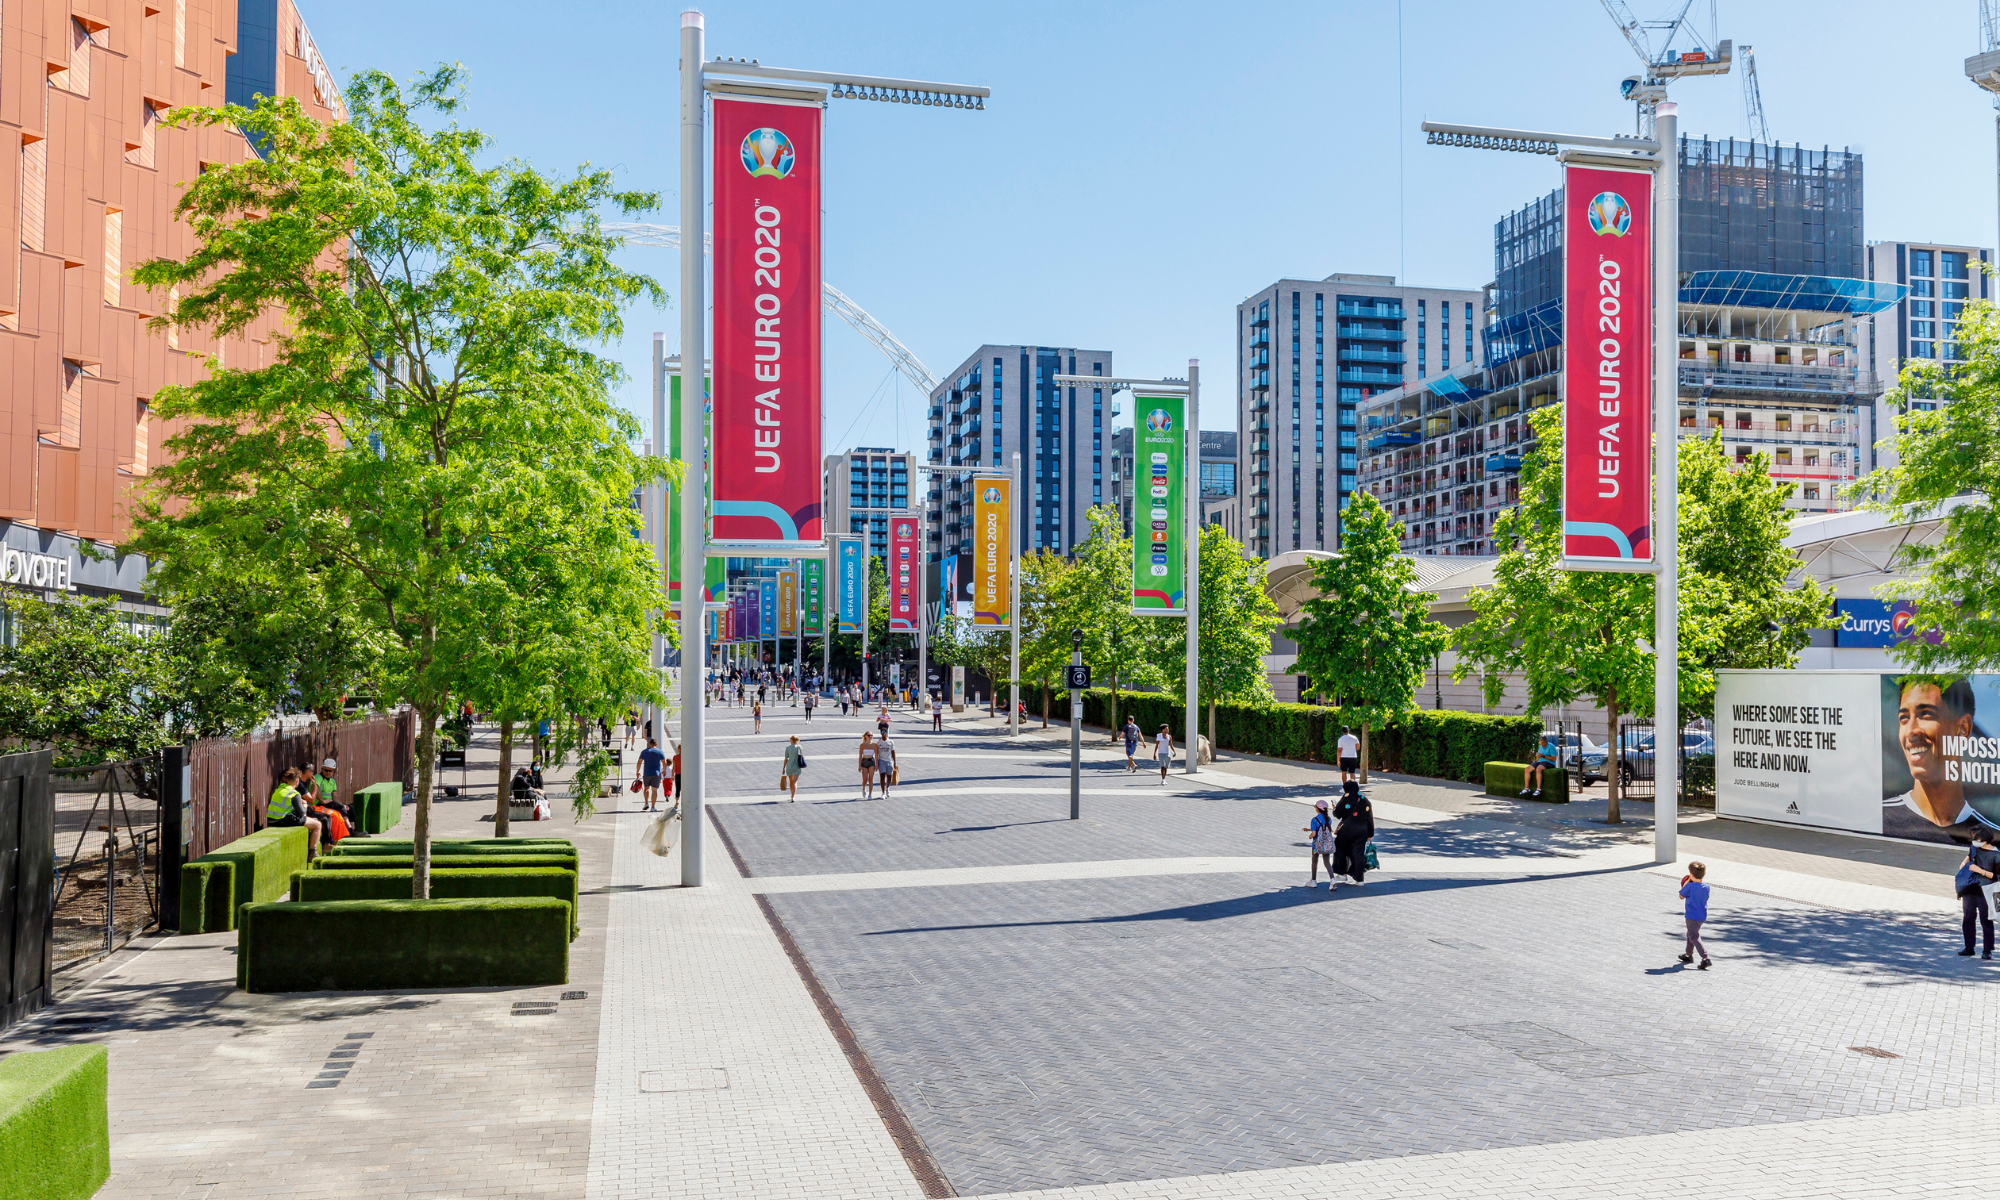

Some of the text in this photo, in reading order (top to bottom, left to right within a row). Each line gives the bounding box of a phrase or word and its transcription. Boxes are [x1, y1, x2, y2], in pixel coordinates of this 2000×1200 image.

[755, 293, 781, 382] EURO
[1599, 338, 1621, 417] EURO
[755, 387, 781, 473] UEFA
[1598, 421, 1620, 498] UEFA
[987, 543, 997, 573] EURO
[987, 573, 997, 603] UEFA
[1842, 616, 1891, 635] Currys
[1732, 704, 1843, 726] WHERE SOME SEE THE
[1733, 728, 1836, 750] FUTURE, WE SEE THE
[1733, 751, 1811, 773] HERE AND NOW.
[1945, 760, 2000, 785] IS NOTH
[1747, 779, 1780, 789] BELLINGHAM
